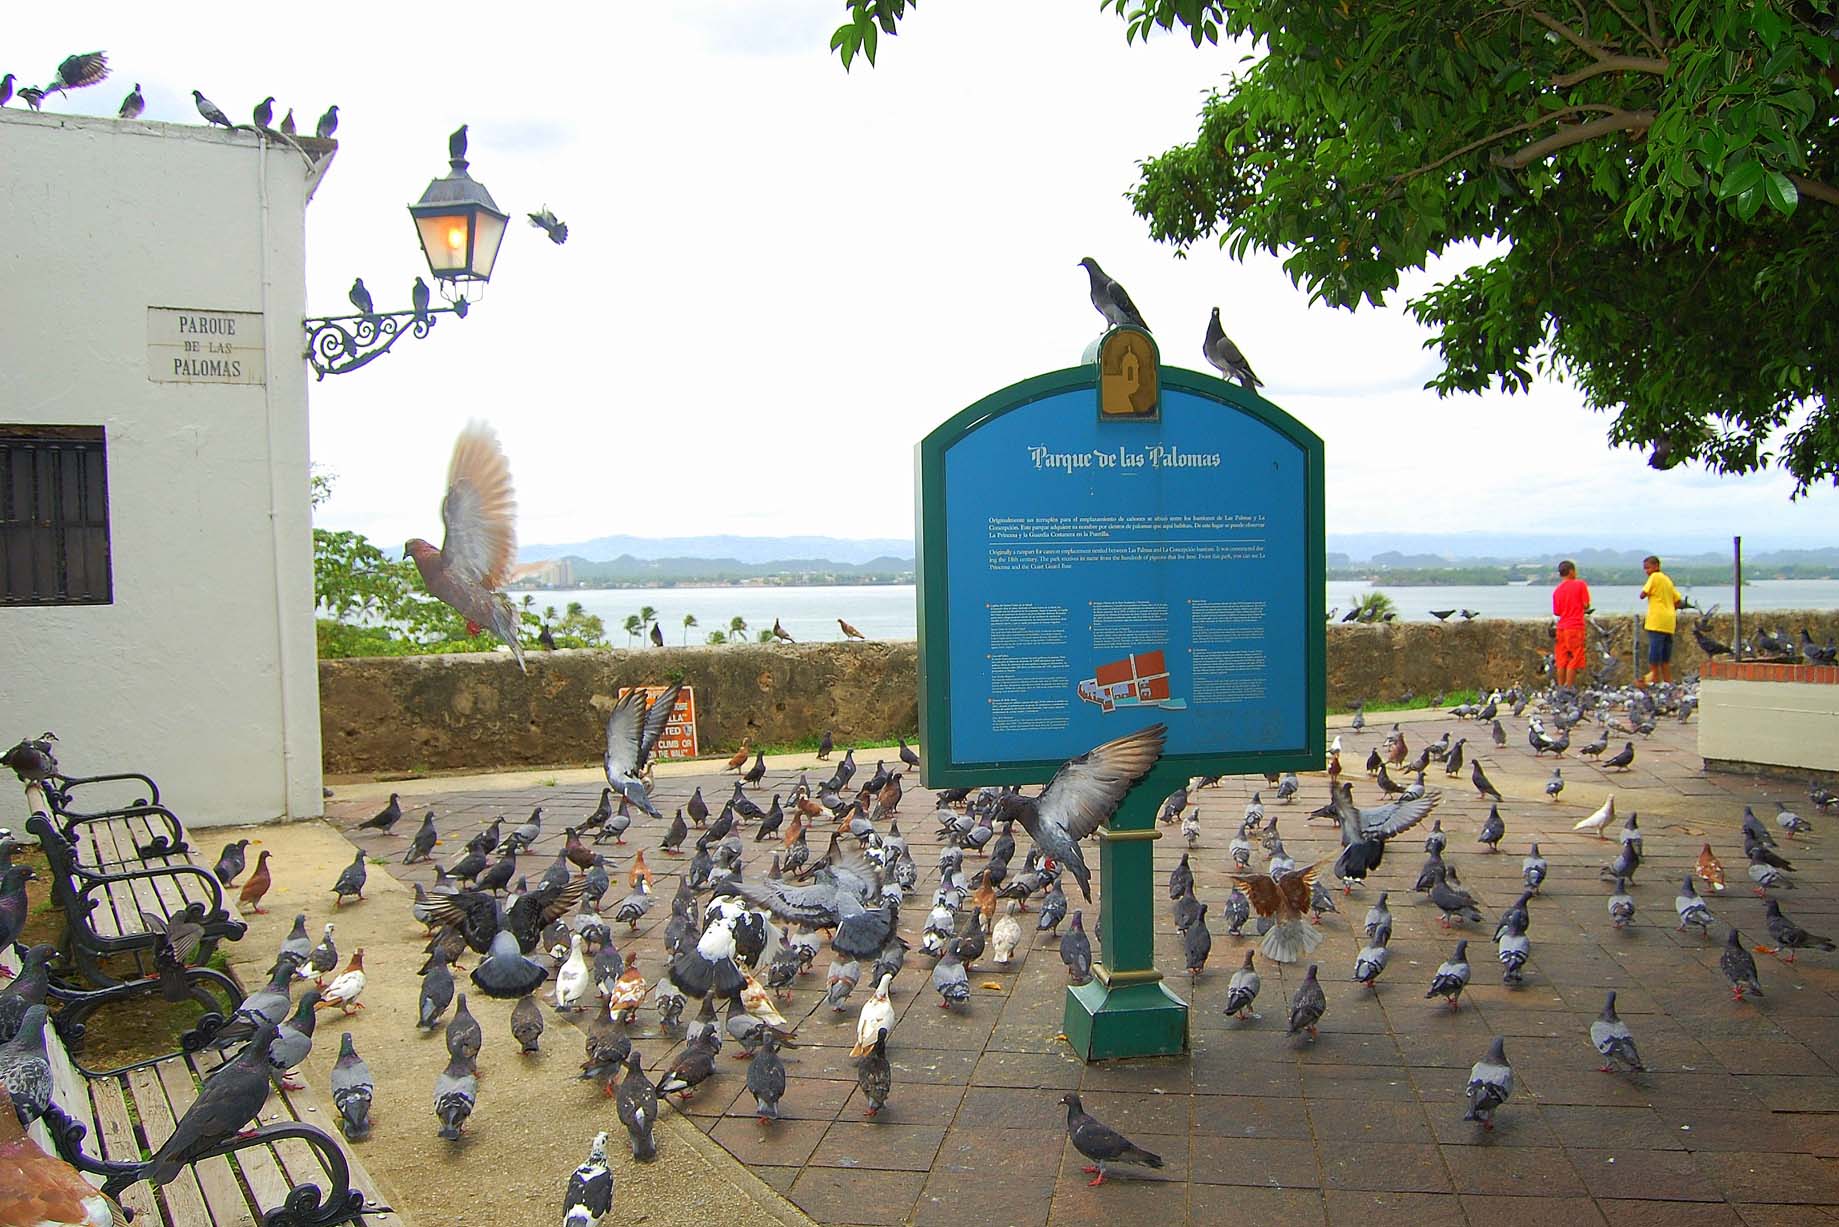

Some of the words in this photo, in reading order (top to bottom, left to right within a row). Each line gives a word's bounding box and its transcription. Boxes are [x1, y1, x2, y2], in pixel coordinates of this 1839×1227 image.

[178, 316, 236, 336] PARQUE
[184, 341, 200, 352] DE
[208, 342, 232, 354] LAS
[174, 358, 241, 377] PALOMAS
[1027, 442, 1092, 474] Parque
[1093, 449, 1116, 468] de
[1120, 446, 1144, 468] las
[1145, 442, 1221, 470] Palomas
